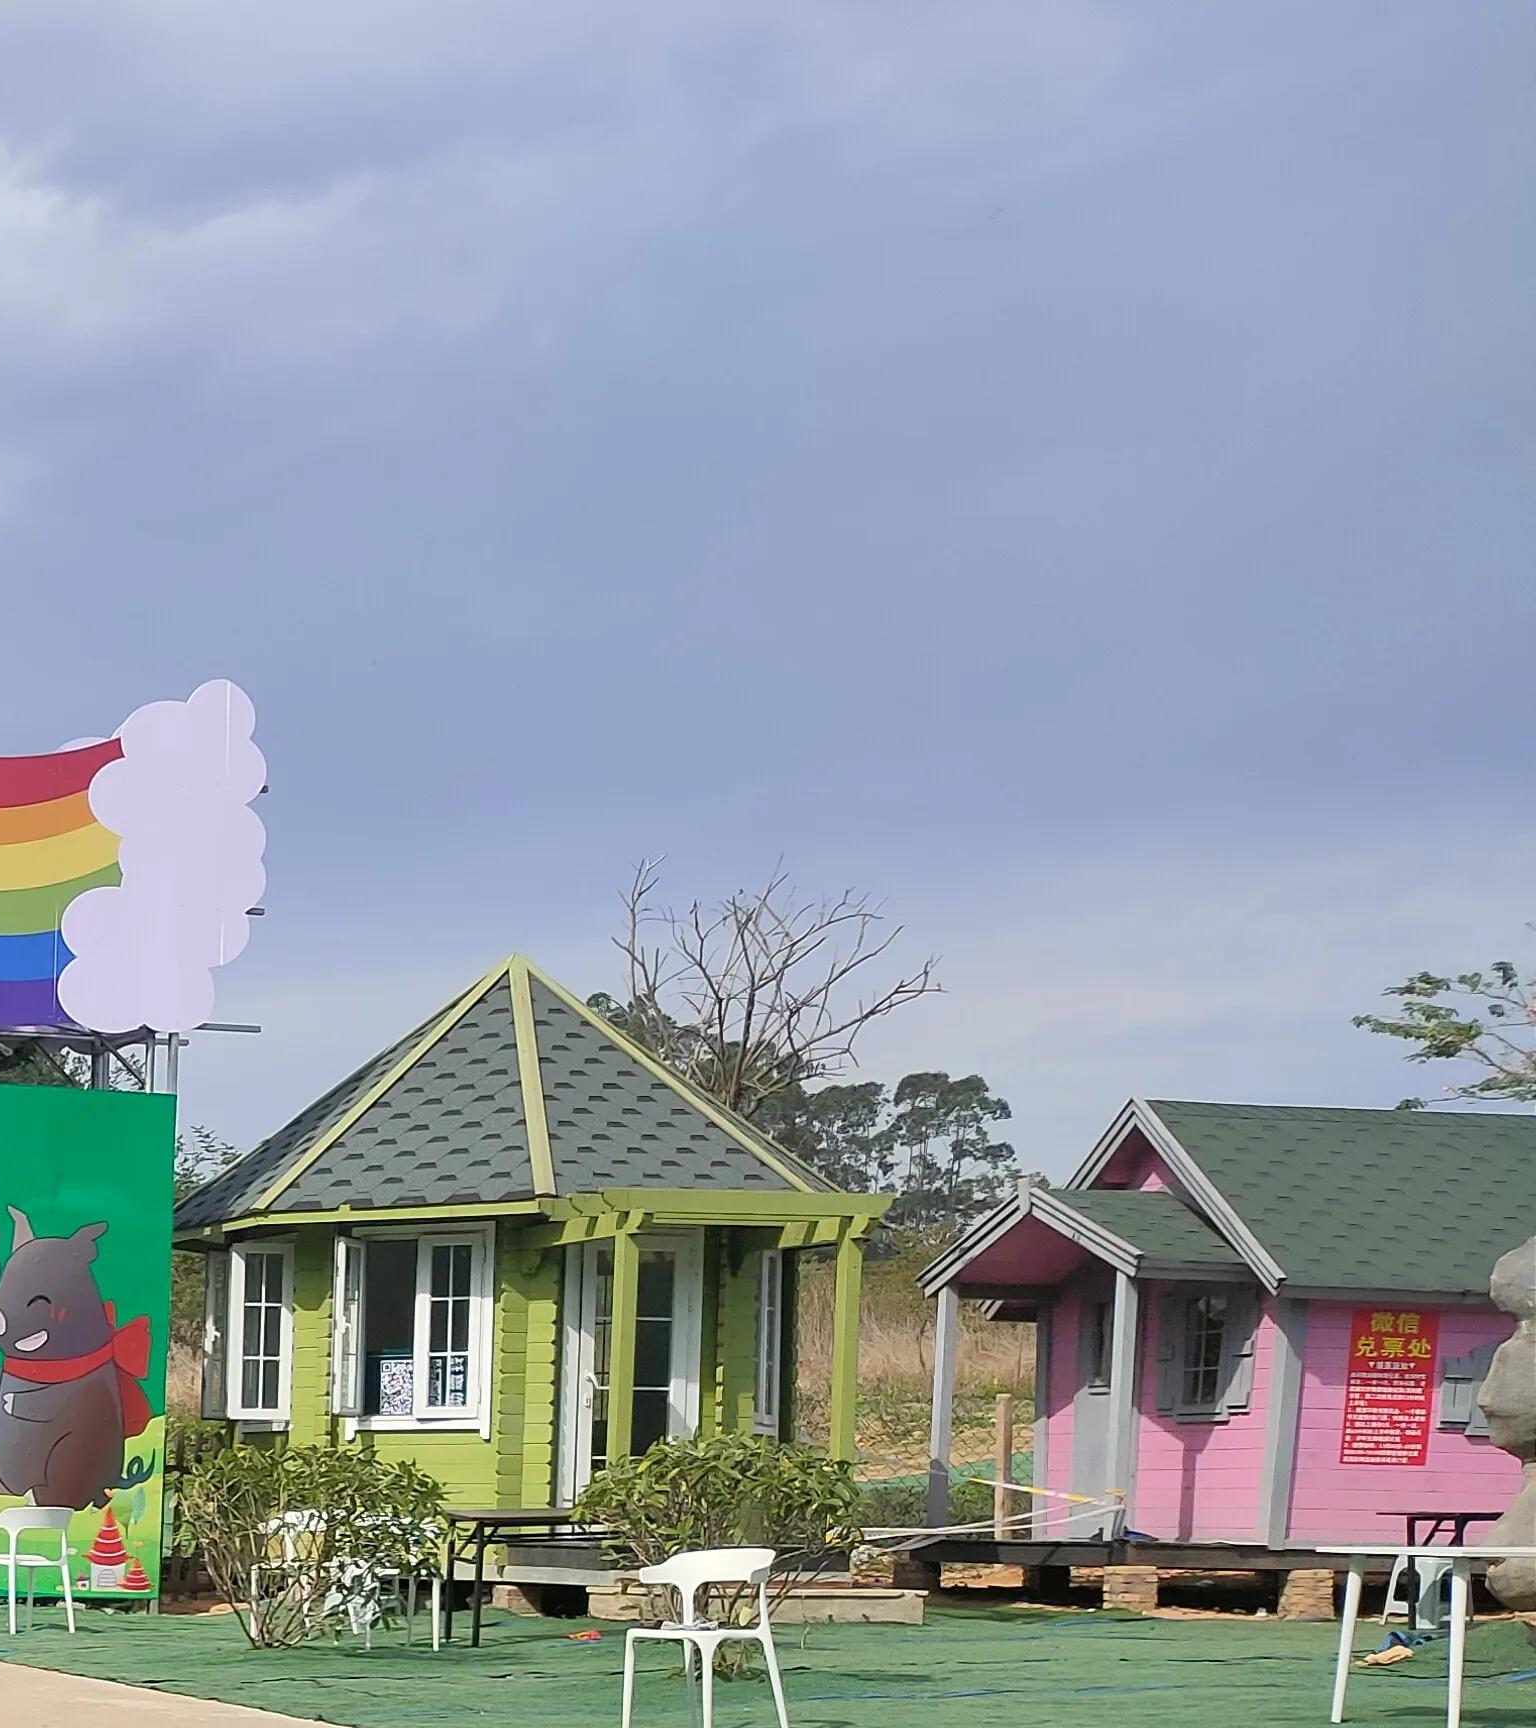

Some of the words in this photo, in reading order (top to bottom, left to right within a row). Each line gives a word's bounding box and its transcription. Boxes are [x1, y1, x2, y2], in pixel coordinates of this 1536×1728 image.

[1371, 1312, 1421, 1334] 微信
[1354, 1336, 1432, 1358] 兑票处
